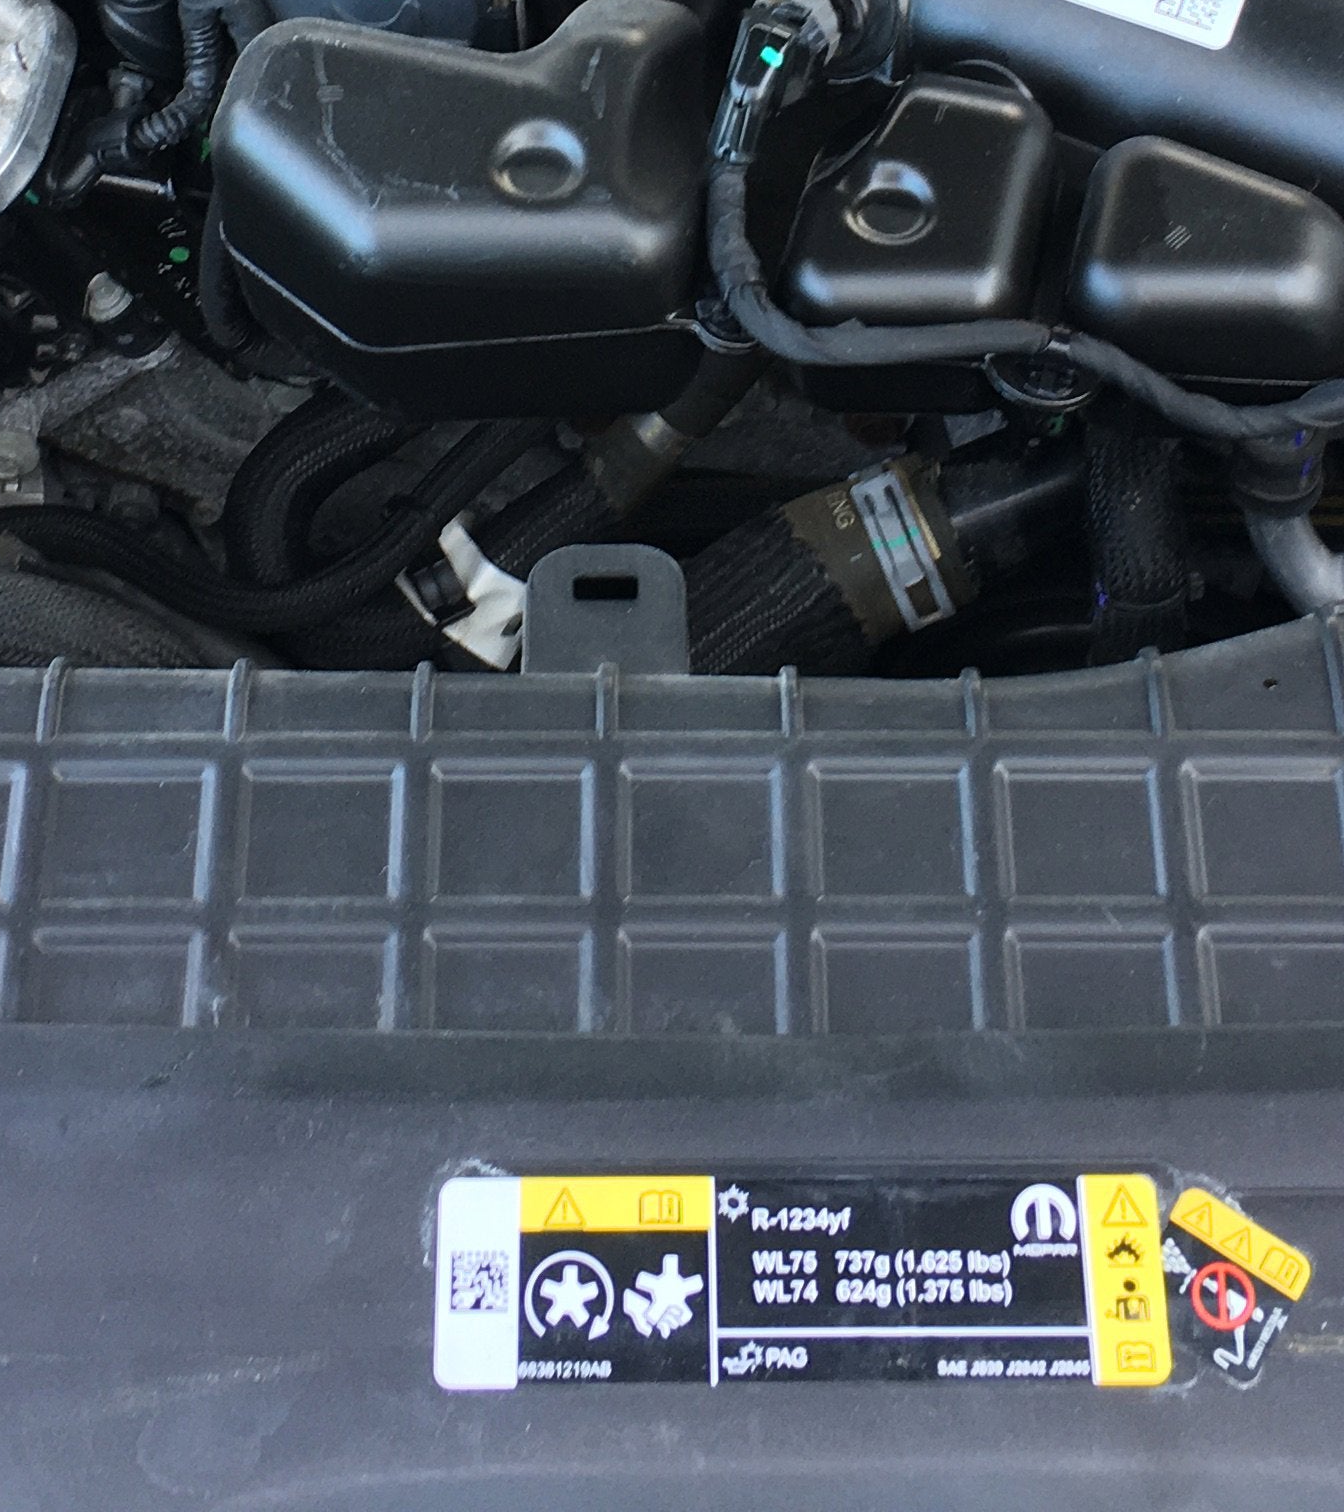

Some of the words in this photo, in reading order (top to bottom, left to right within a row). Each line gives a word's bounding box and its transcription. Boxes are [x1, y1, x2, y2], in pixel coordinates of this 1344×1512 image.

[751, 1206, 852, 1237] R-1234yf
[751, 1250, 819, 1275] WL75
[834, 1249, 891, 1279] 737g
[894, 1248, 963, 1279] (1.625
[966, 1248, 1011, 1279] lbs)
[752, 1278, 819, 1304] WL74
[835, 1278, 892, 1308] 624g
[895, 1277, 965, 1308] (1.375
[968, 1277, 1013, 1308] lbs)
[765, 1346, 808, 1370] PAG
